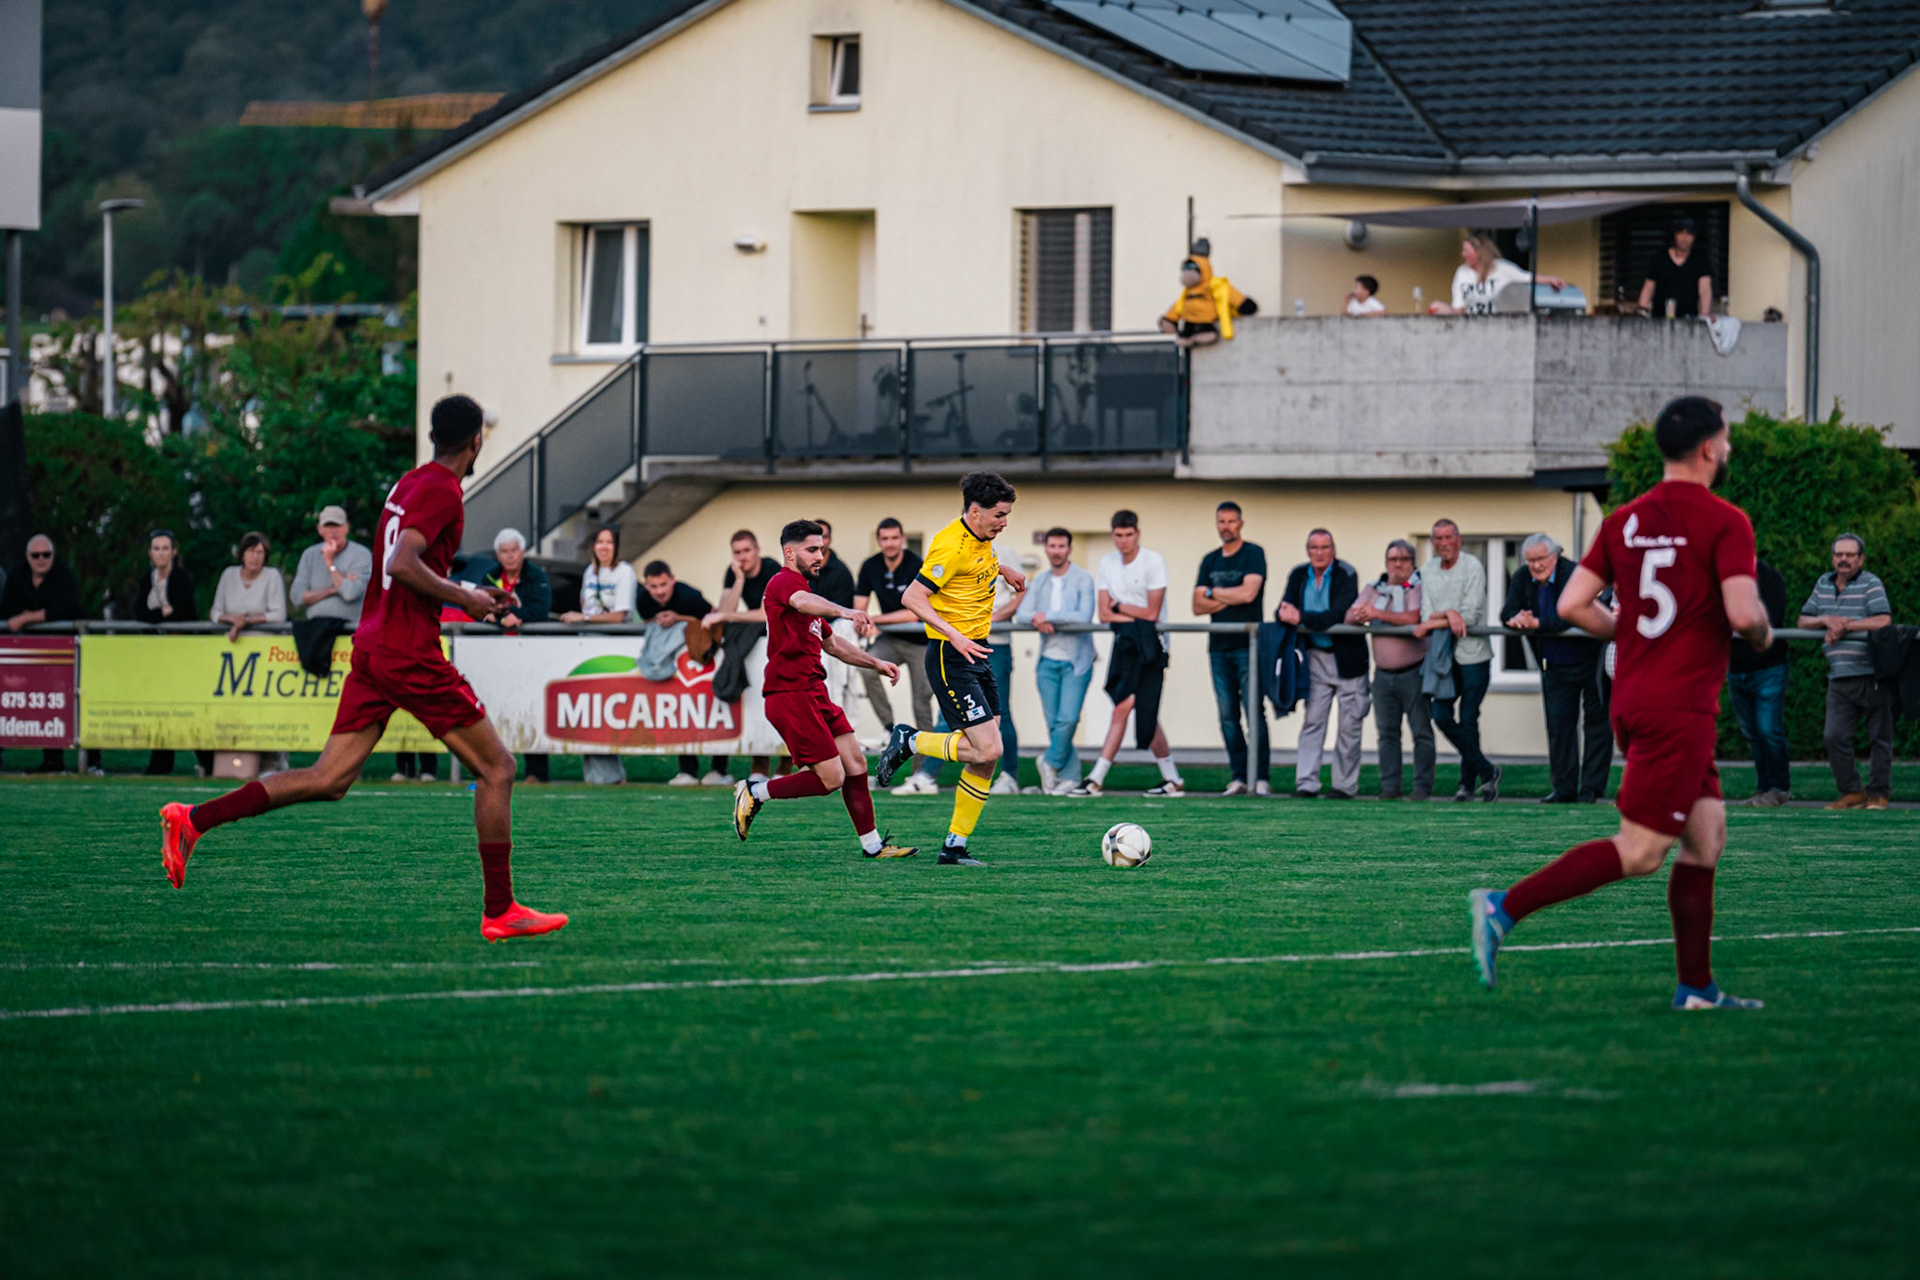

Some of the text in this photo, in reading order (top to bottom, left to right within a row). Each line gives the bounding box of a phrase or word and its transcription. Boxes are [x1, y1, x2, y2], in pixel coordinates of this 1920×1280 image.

[1636, 547, 1678, 639] 5
[1, 691, 65, 710] 675 33 35
[556, 692, 735, 730] MICARNA
[963, 693, 976, 709] 3
